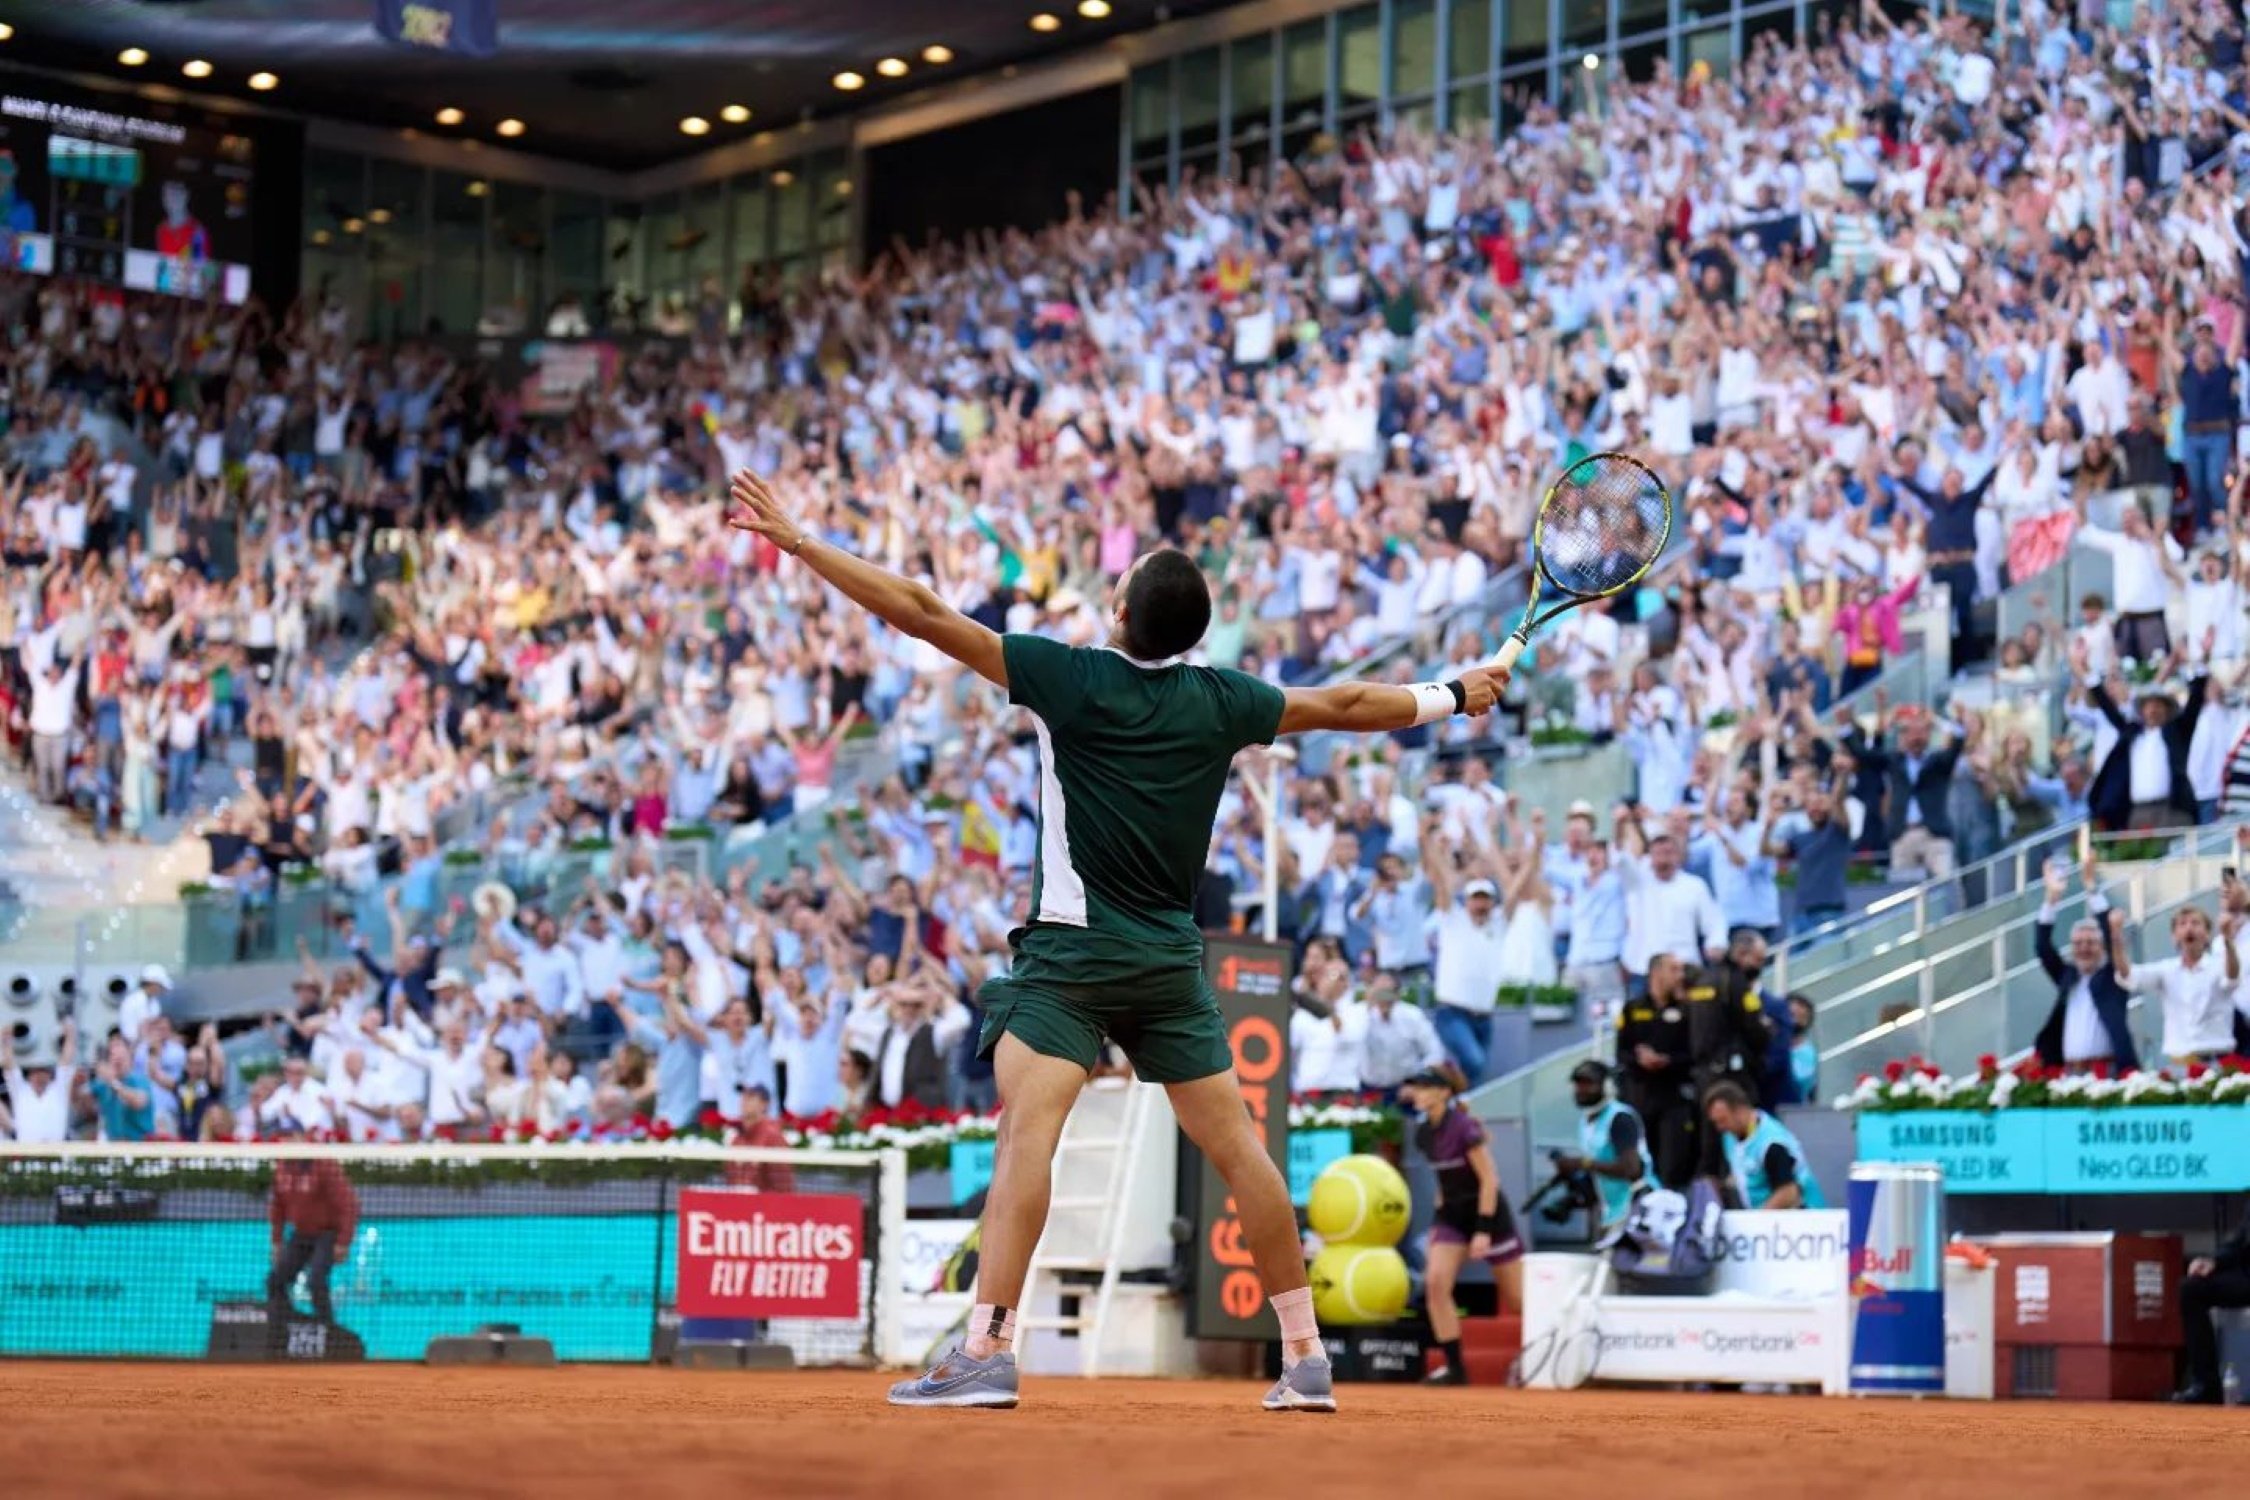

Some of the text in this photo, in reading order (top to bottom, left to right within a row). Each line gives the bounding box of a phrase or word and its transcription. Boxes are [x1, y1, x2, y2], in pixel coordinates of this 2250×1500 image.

[1890, 1123, 1996, 1147] SAMSUNG
[2078, 1119, 2193, 1145] SAMSUNG
[1210, 1015, 1283, 1319] Orge
[2078, 1154, 2208, 1180] Neo QLED 8K
[687, 1211, 854, 1260] Emirates
[1713, 1221, 1849, 1262] penban
[1865, 1248, 1912, 1274] Bull
[710, 1260, 828, 1298] FLY BETTER
[1597, 1330, 1675, 1353] penbank
[1703, 1329, 1795, 1355] Openbank
